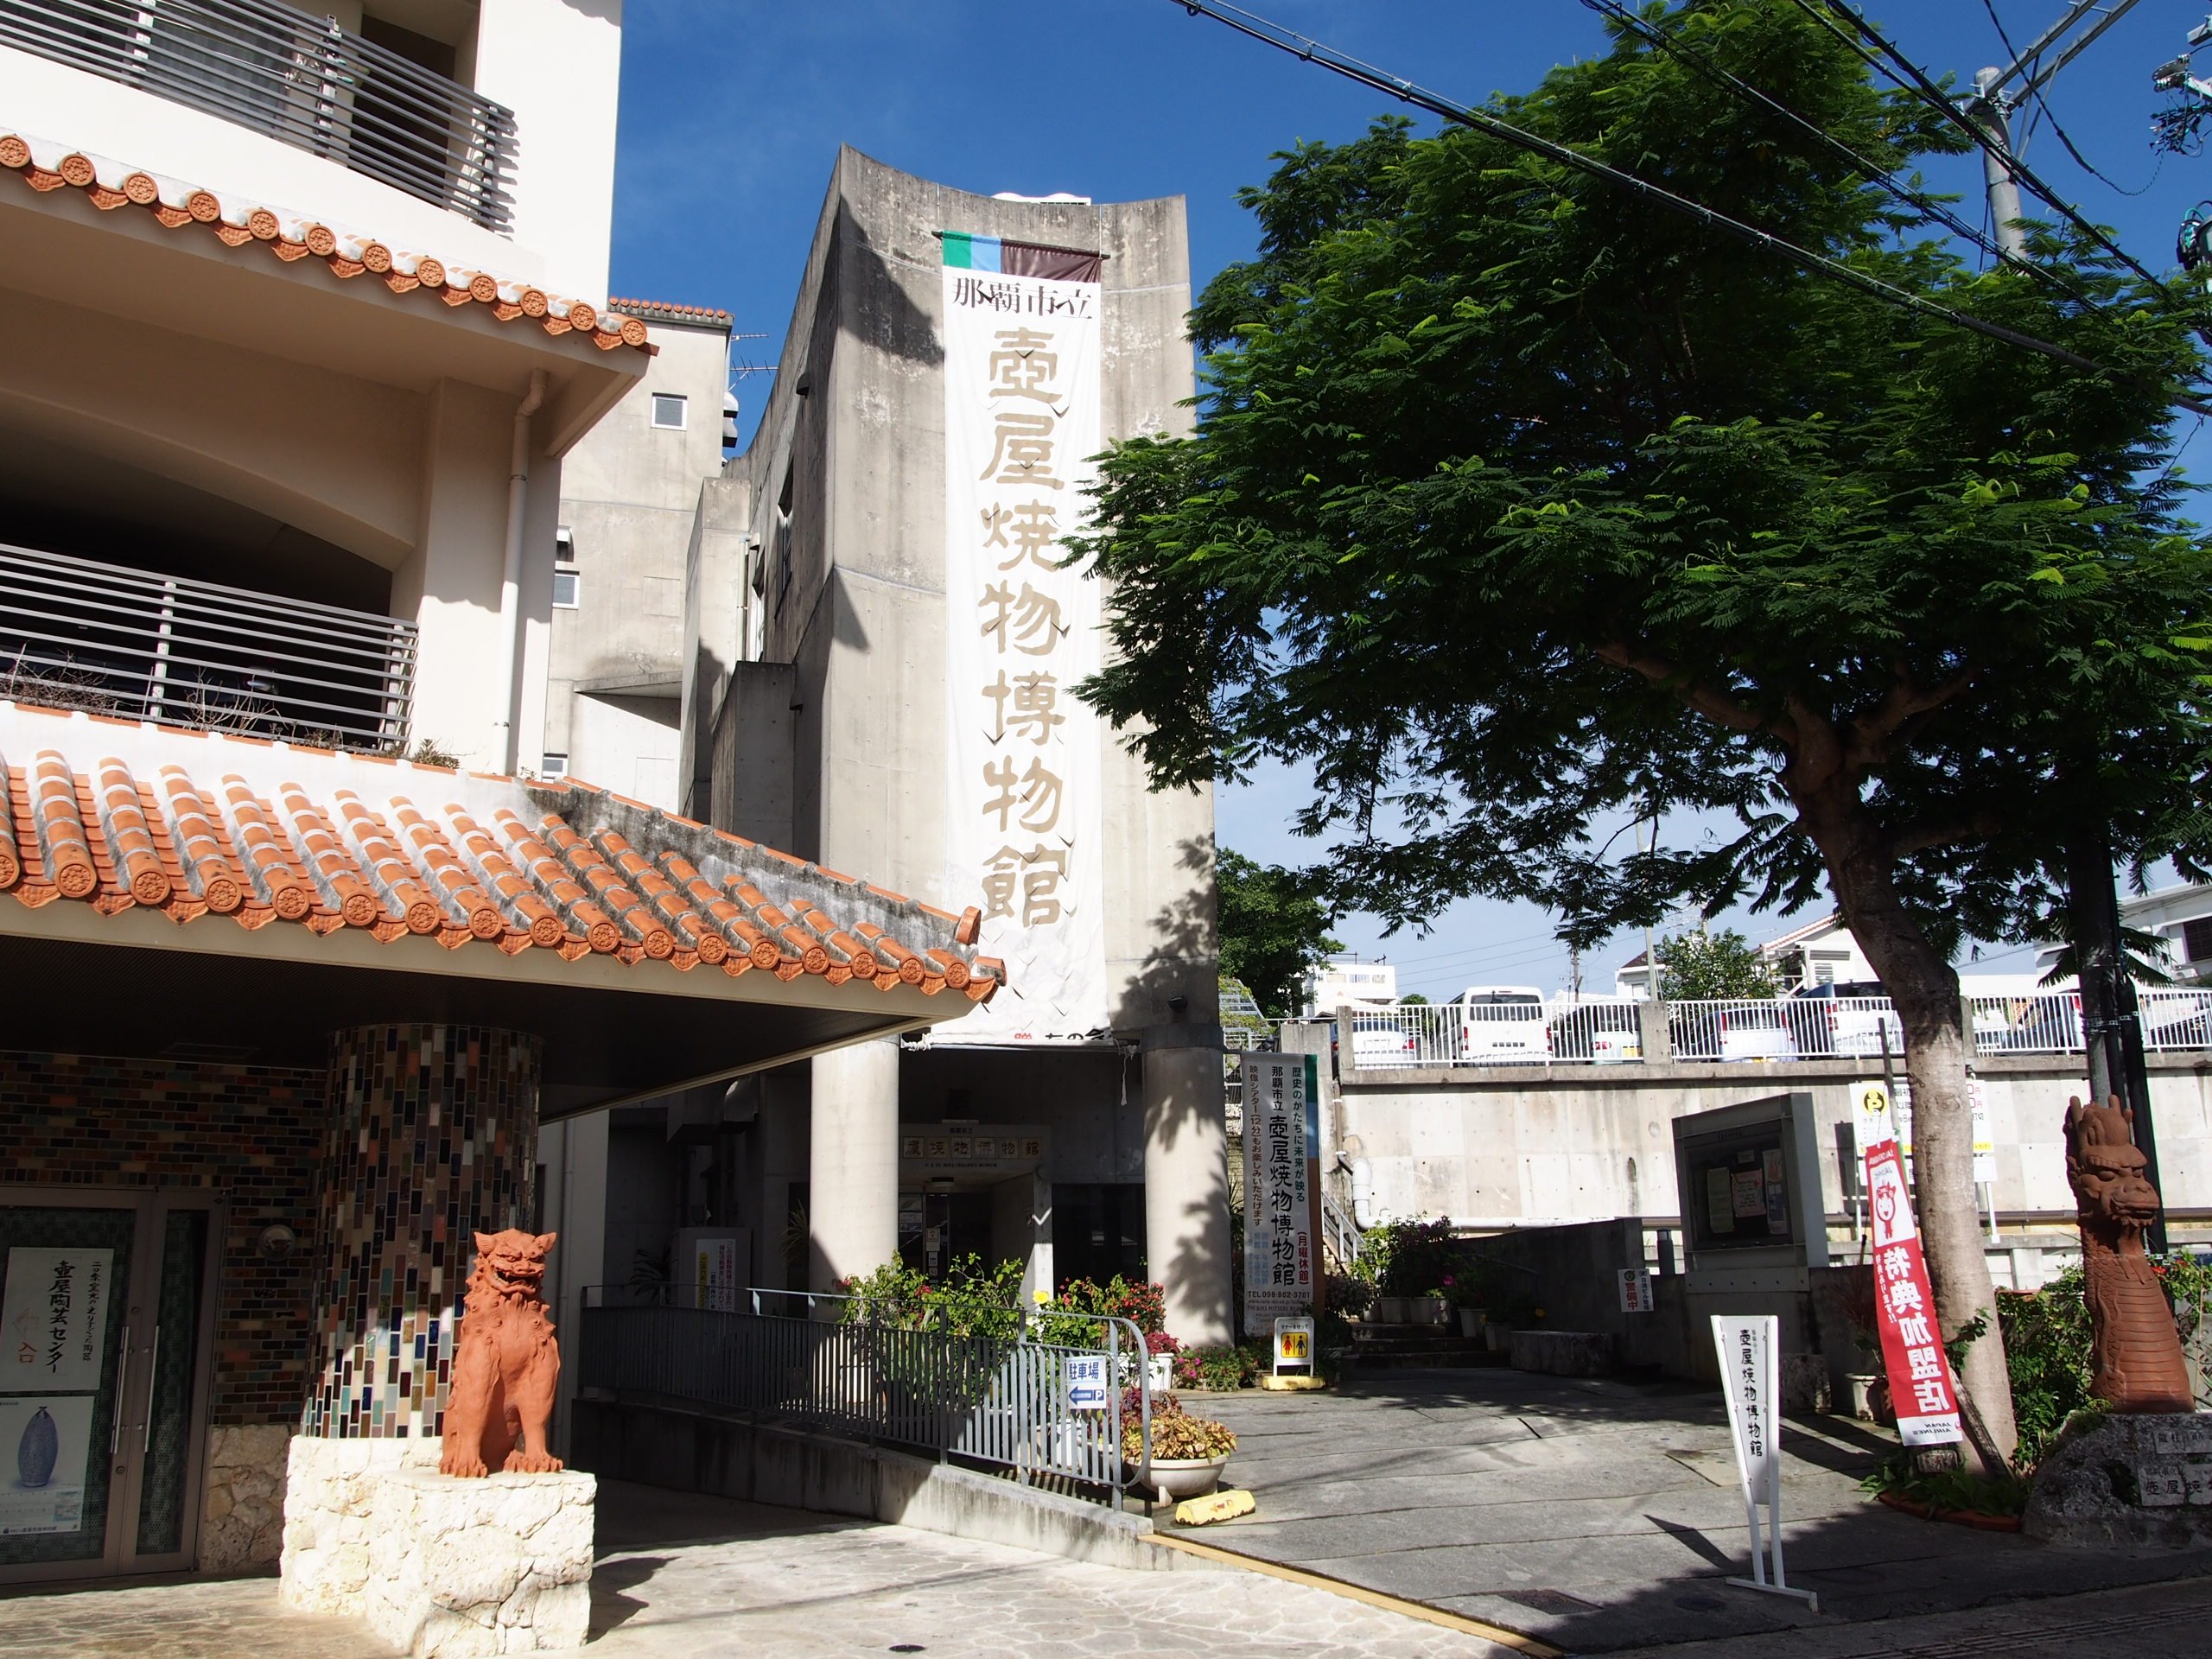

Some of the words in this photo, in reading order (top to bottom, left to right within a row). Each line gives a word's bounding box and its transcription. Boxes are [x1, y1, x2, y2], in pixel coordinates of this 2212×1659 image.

[952, 276, 1093, 320] 那覇市立
[1271, 1065, 1284, 1111] 那覇市立
[1292, 1066, 1306, 1203] 歴史のかたちに未来が映る
[18, 1341, 38, 1363] 入口
[1069, 1362, 1099, 1381] 駐車場
